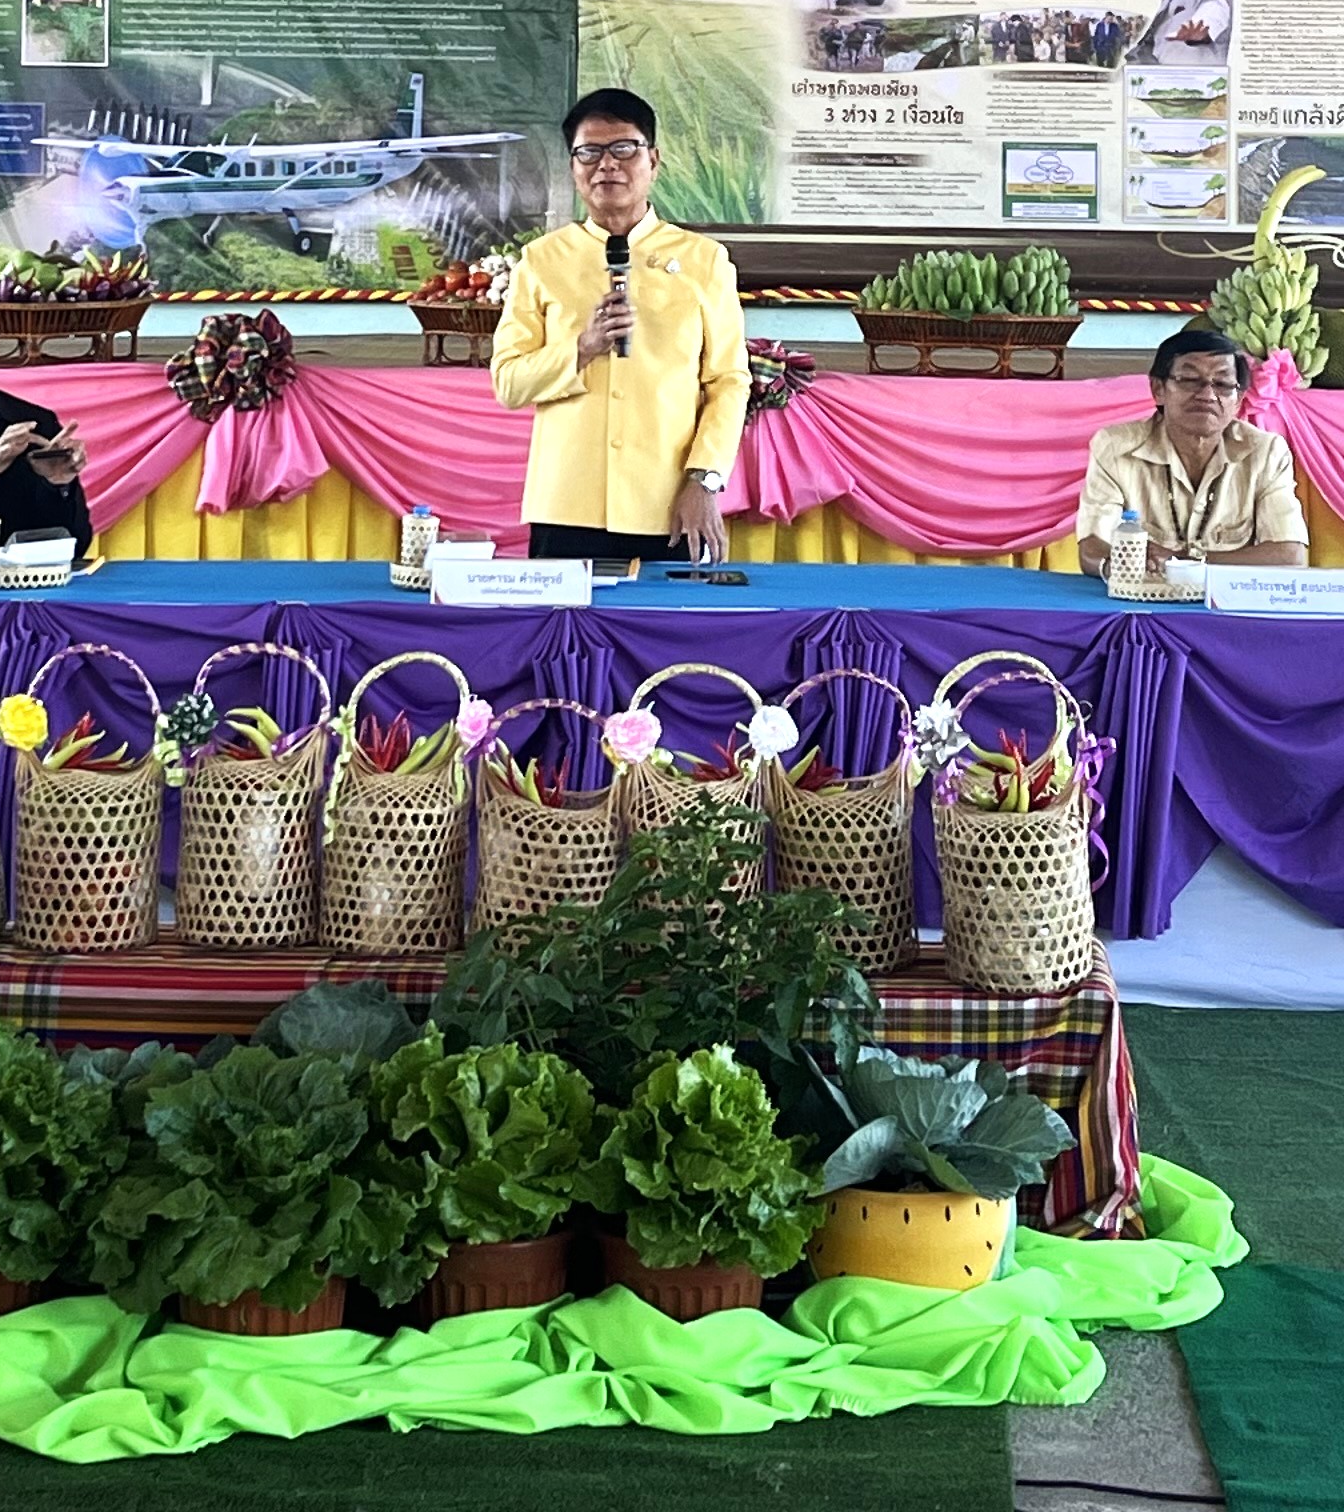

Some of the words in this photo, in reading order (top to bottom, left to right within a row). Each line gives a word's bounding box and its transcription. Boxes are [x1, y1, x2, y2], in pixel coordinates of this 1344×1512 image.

[791, 79, 919, 101] เศรษฐกิจพอเพียง
[824, 107, 836, 124] 3
[841, 104, 878, 125] ห่วง
[884, 107, 896, 124] 2
[902, 99, 965, 125] เงื่อนไข
[1238, 106, 1279, 125] ทฤษฎี
